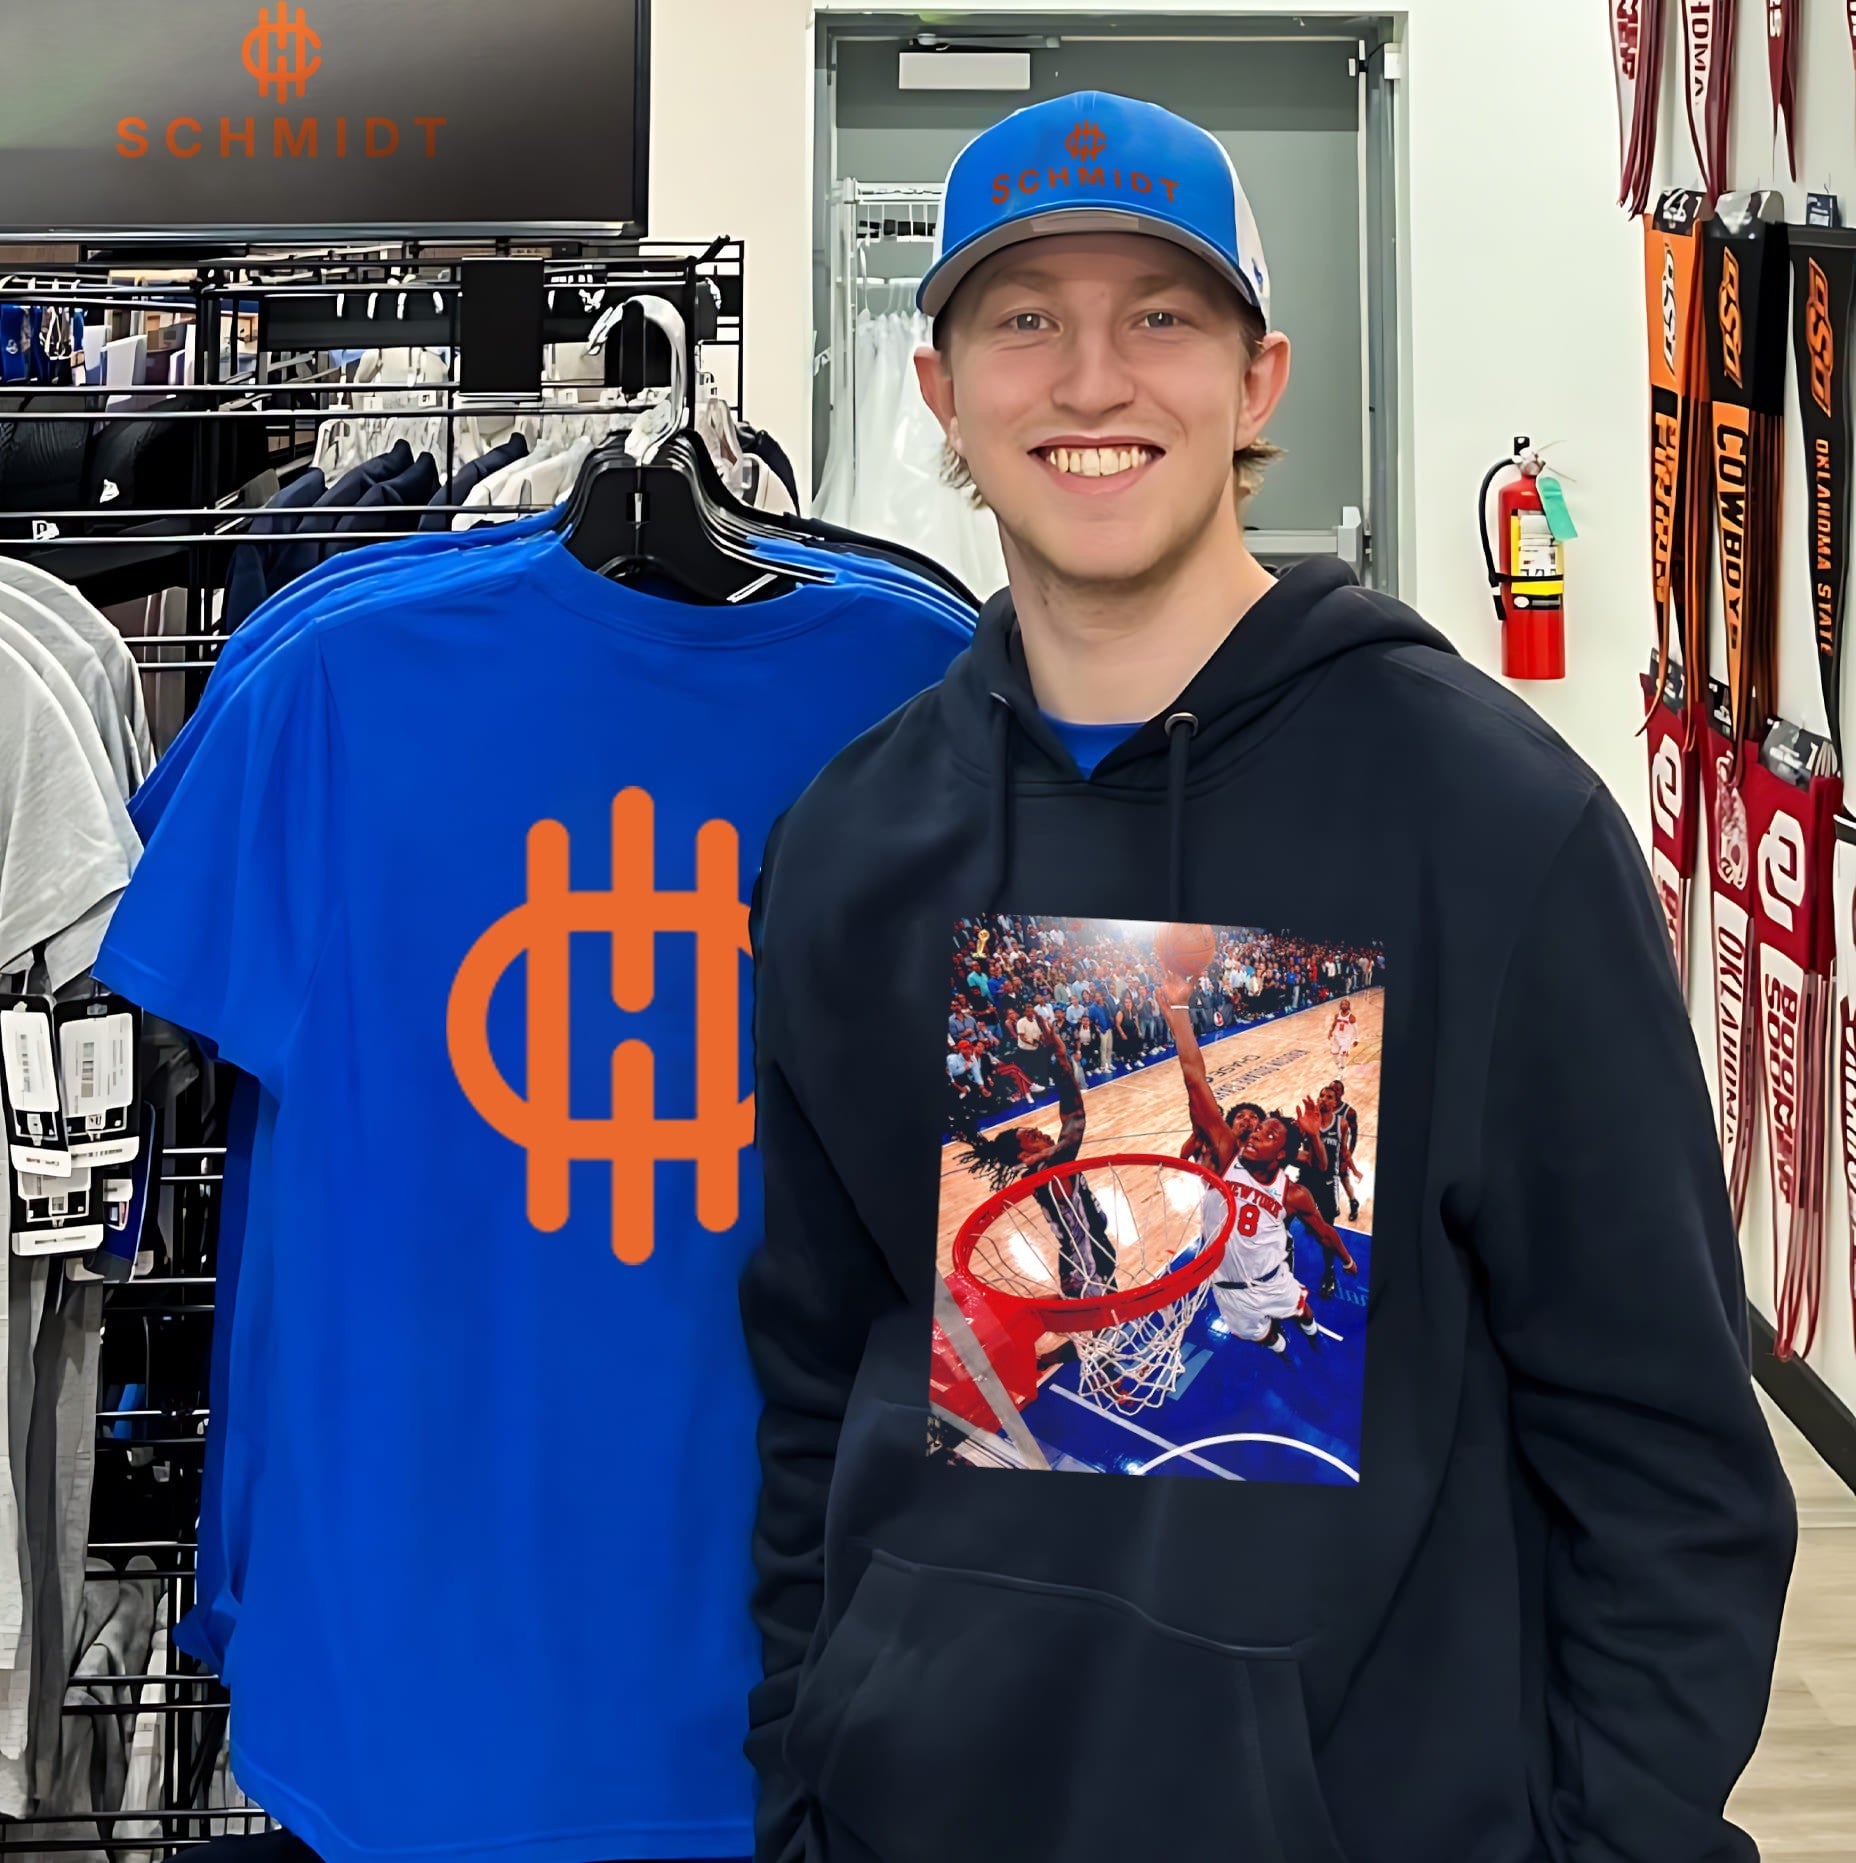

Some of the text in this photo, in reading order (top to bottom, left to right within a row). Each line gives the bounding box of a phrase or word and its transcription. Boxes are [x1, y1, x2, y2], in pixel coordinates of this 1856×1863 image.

[116, 116, 448, 159] SCHMIDT
[991, 166, 1180, 204] SCHMIDT
[1816, 439, 1832, 571] OKLAHOMA
[1236, 1203, 1260, 1238] 8
